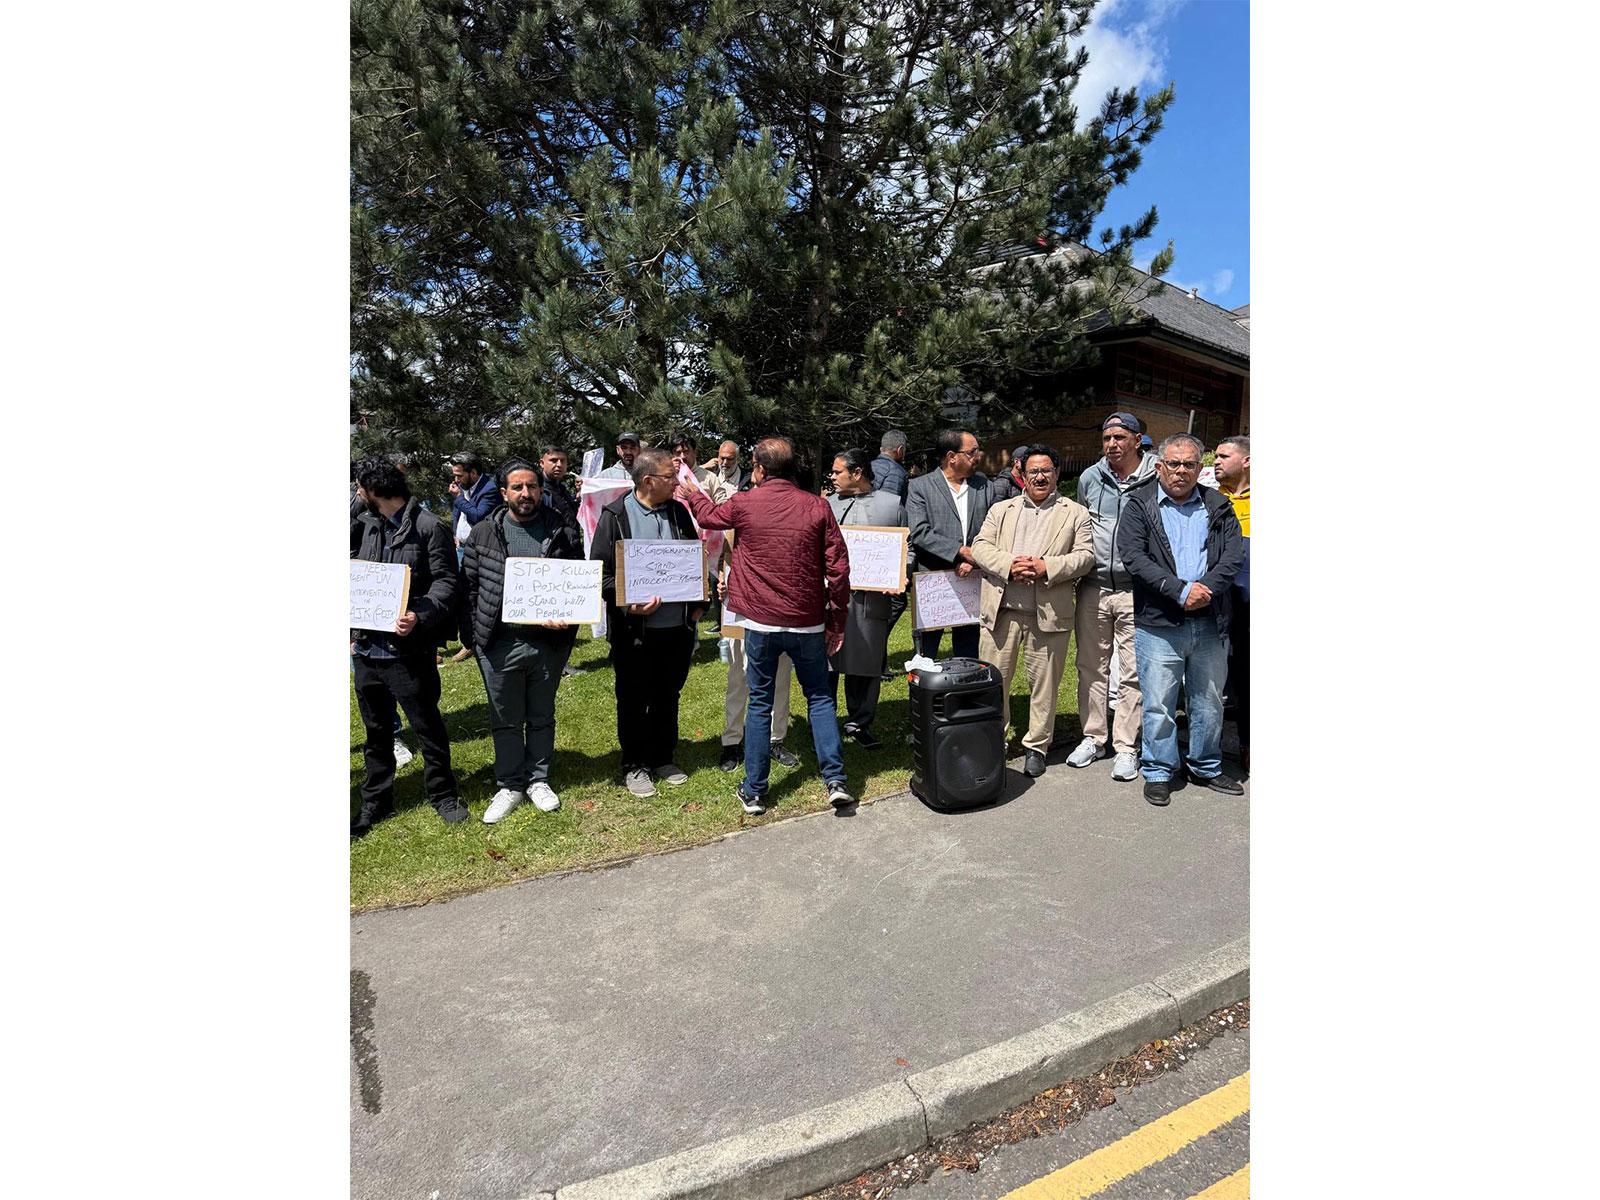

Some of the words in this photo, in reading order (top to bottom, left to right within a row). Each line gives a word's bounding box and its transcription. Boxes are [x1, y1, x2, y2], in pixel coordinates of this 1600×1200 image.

[628, 544, 644, 558] UK
[861, 548, 884, 561] THE
[364, 563, 387, 574] NEED
[513, 561, 551, 576] STOP
[376, 573, 392, 584] UN
[629, 576, 672, 588] INNOCENT
[528, 595, 557, 606] STAND
[508, 608, 527, 618] OUR
